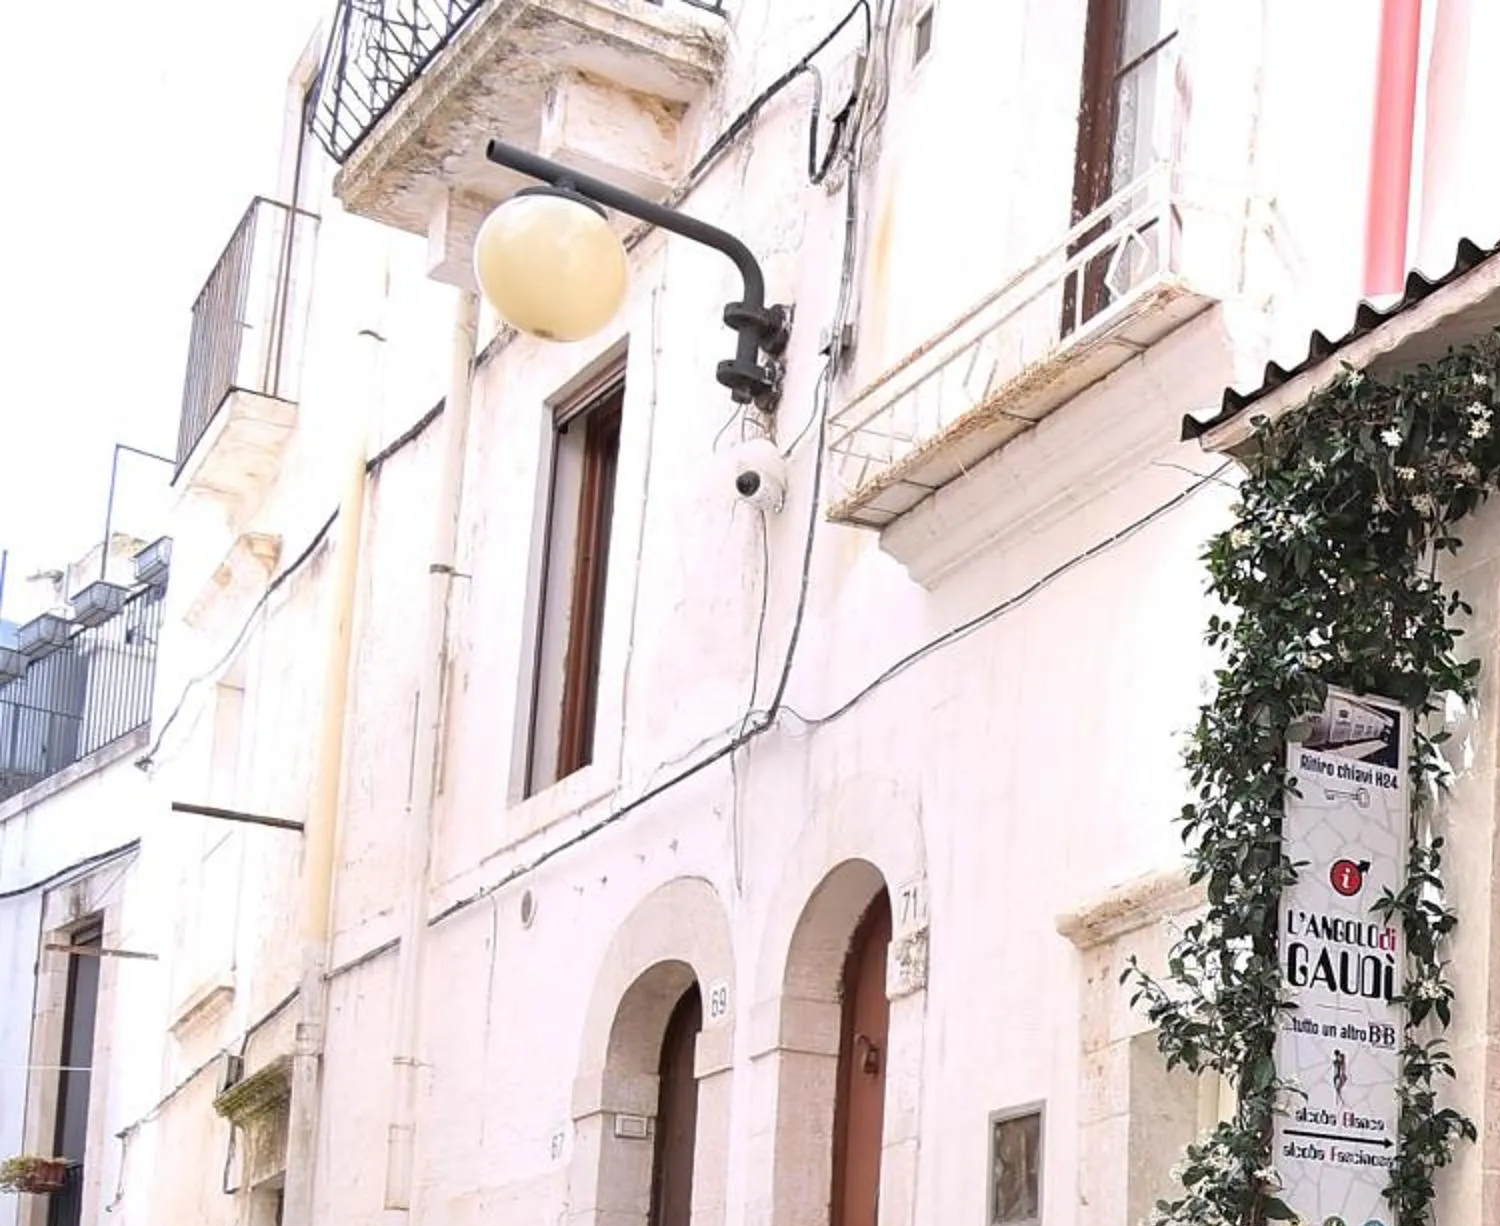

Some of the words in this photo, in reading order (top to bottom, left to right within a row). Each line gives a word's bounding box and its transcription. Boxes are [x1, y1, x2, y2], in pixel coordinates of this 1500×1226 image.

[1301, 754, 1335, 777] Ritiro
[1337, 763, 1373, 784] chiavi
[1375, 771, 1399, 789] H24
[711, 987, 726, 1017] 69
[1322, 1024, 1337, 1038] un
[1341, 1024, 1367, 1042] altro
